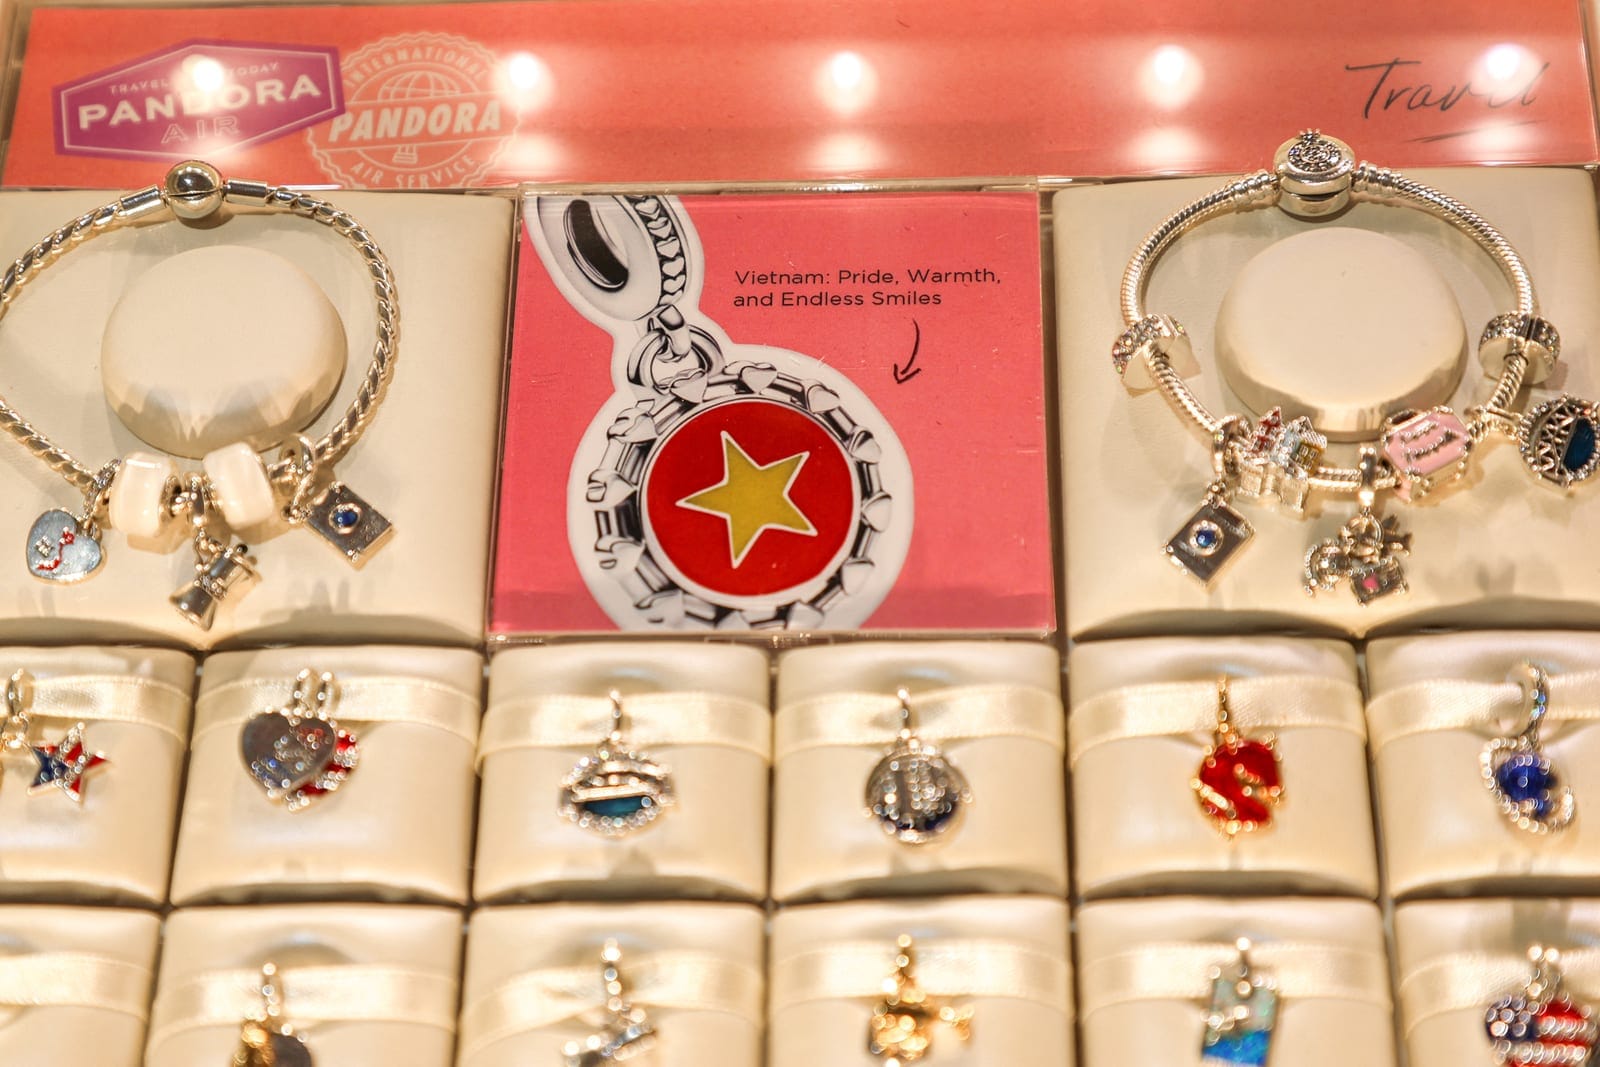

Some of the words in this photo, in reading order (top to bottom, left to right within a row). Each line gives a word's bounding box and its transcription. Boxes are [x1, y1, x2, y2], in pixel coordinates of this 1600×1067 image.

[109, 79, 170, 96] TRAVEL
[228, 62, 280, 77] TODAY
[343, 47, 487, 88] INTERNATIONAL
[78, 74, 322, 131] PANDORA
[160, 115, 241, 144] AIR
[328, 100, 501, 142] PANDORA
[350, 161, 384, 184] AIR
[395, 155, 476, 188] SERVICE
[734, 270, 830, 285] Vietnam:
[838, 269, 900, 286] Pride,
[907, 268, 1001, 285] Warmth,
[733, 292, 774, 307] and
[781, 291, 865, 306] Endless
[871, 290, 942, 305] Smiles
